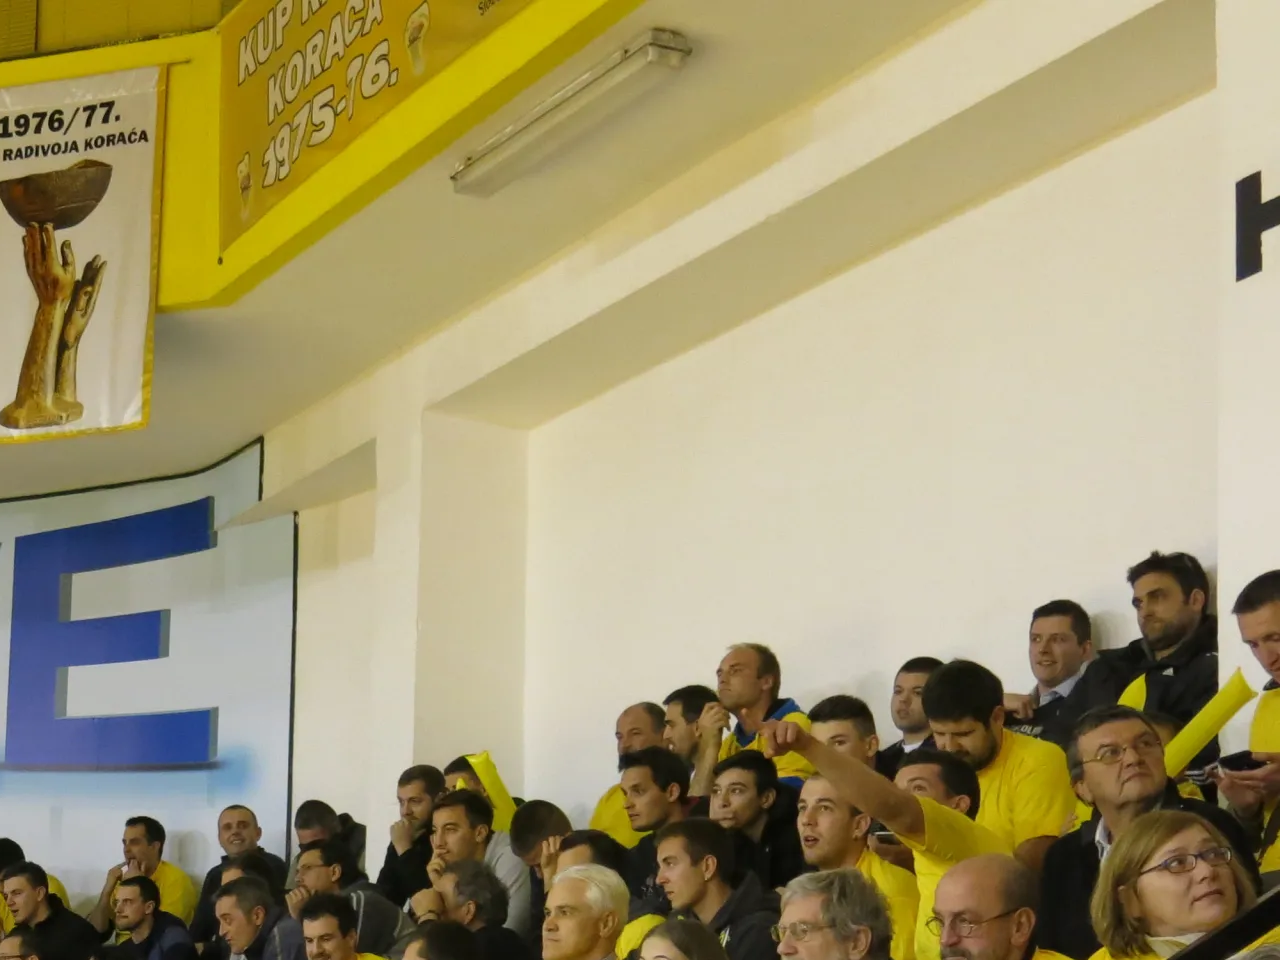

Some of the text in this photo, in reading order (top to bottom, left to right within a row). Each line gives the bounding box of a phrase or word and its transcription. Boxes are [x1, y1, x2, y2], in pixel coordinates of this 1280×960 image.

[238, 0, 294, 87] KUP
[2, 139, 80, 161] RADIVOJA
[84, 127, 150, 152] KORAĆA
